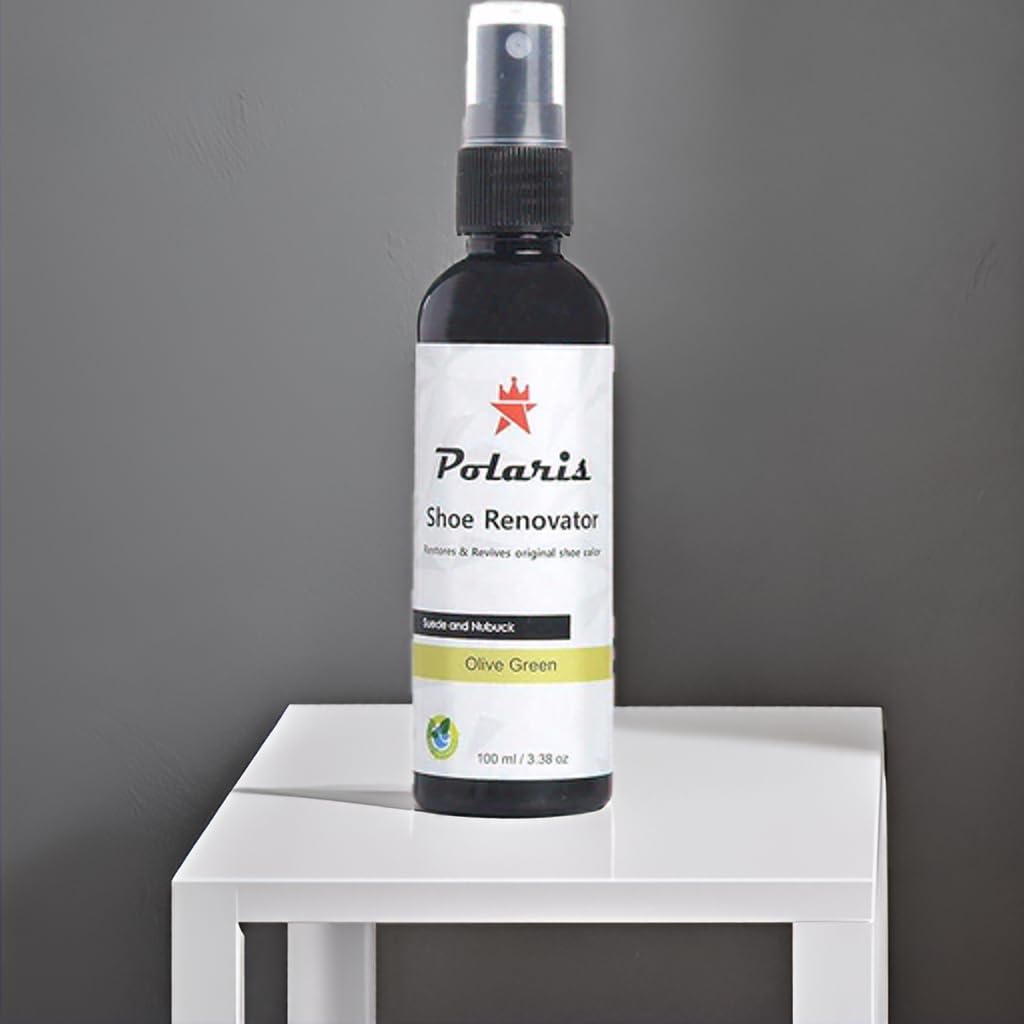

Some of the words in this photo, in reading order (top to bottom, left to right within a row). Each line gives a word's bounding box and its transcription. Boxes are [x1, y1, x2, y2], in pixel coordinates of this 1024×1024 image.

[436, 447, 591, 481] Polaris
[426, 506, 475, 529] Shoe
[485, 509, 599, 531] Renovator
[459, 546, 468, 557] &
[472, 547, 511, 558] Revives
[515, 547, 556, 560] original
[559, 547, 580, 558] shoe
[449, 620, 469, 632] and
[471, 621, 515, 633] Nubuck
[465, 656, 505, 672] Olive
[509, 657, 557, 673] Green
[477, 753, 499, 765] 100
[501, 753, 517, 765] ml
[527, 753, 553, 766] 3.38
[555, 755, 569, 765] oz
